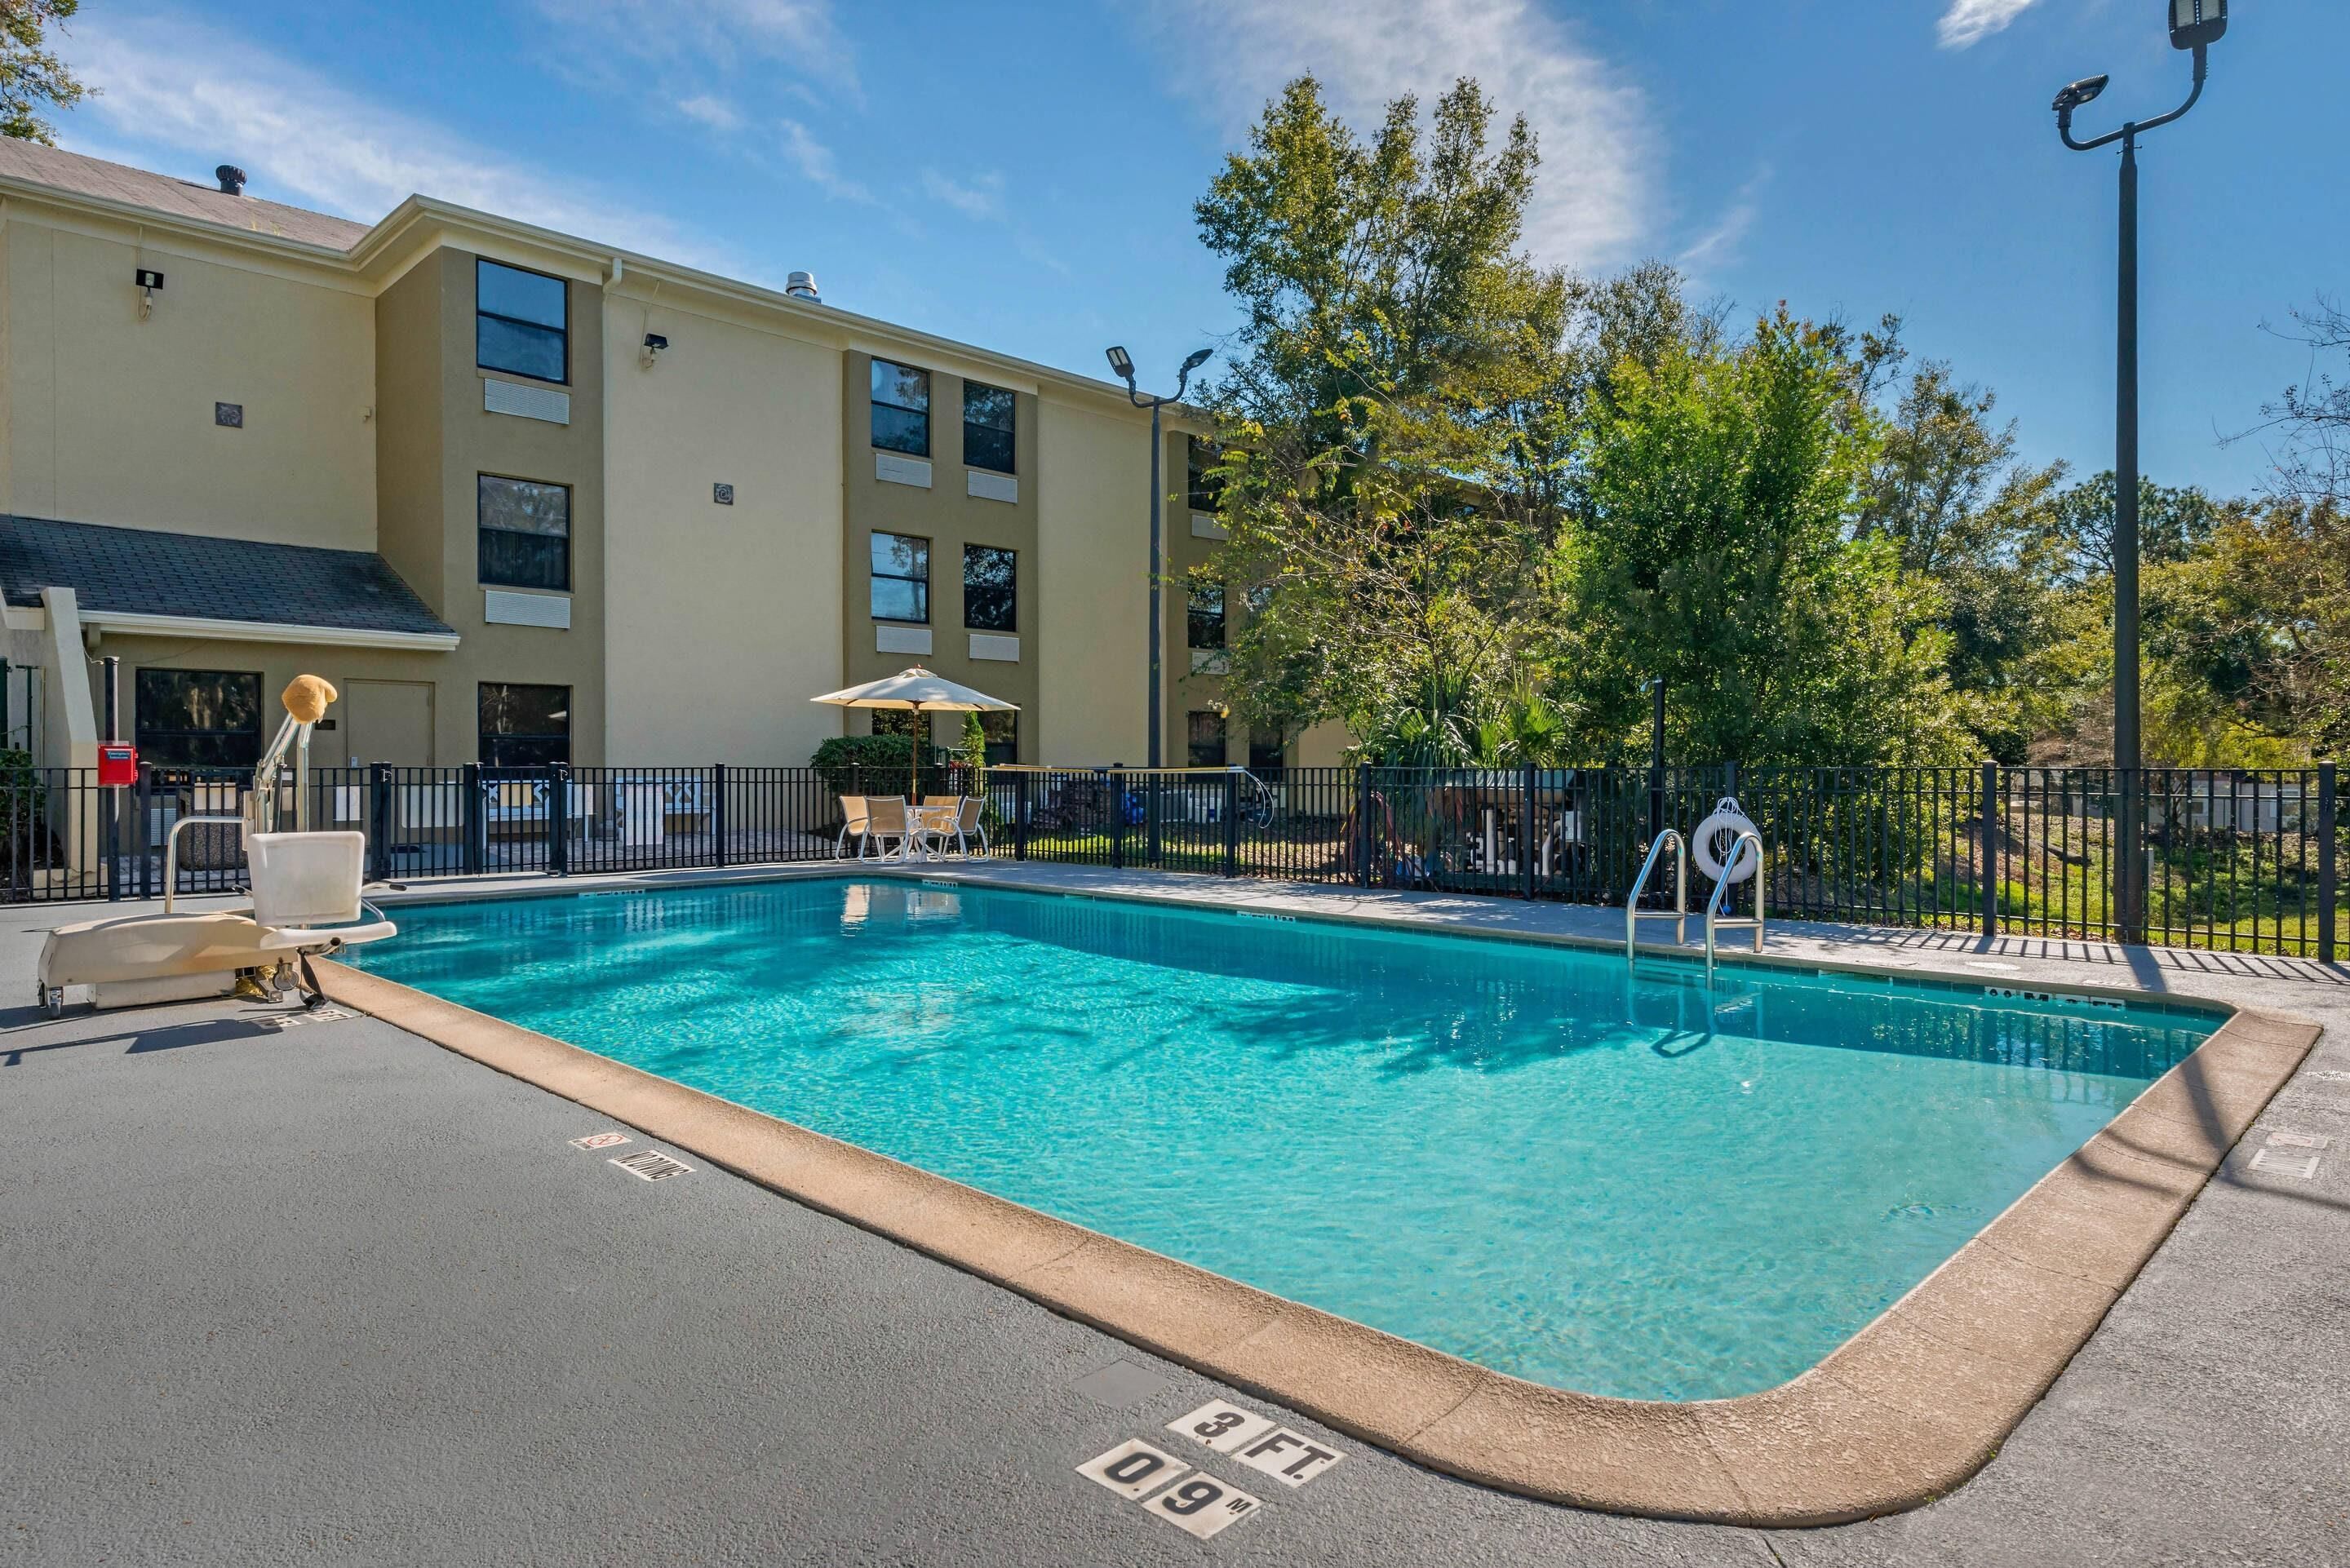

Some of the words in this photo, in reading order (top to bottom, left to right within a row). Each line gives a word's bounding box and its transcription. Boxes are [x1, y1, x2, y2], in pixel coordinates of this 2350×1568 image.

[613, 1151, 658, 1163] NO
[627, 1158, 689, 1180] DIVING
[1194, 1412, 1245, 1437] 3
